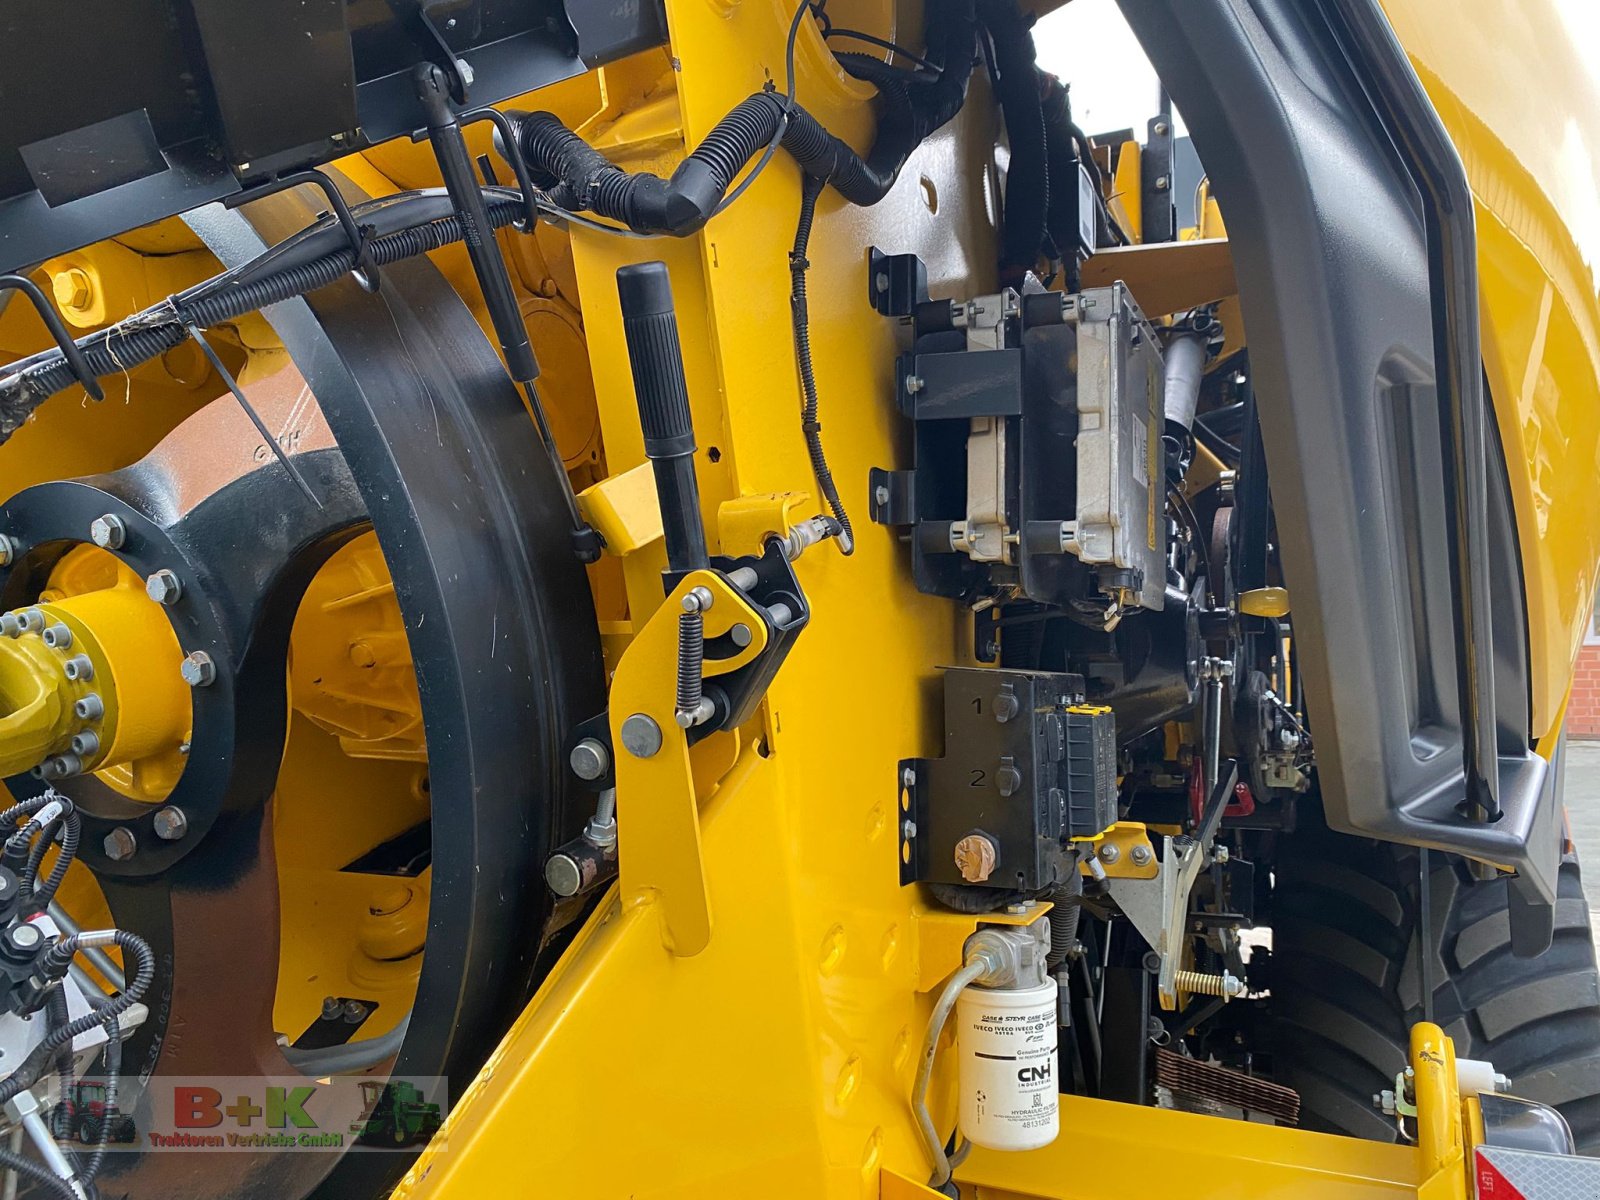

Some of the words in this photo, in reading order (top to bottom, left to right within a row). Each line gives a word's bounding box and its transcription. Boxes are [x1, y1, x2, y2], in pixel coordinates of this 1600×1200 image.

[971, 697, 981, 714] 1
[970, 769, 986, 787] 2
[973, 1024, 993, 1032] IVECO
[1018, 1062, 1051, 1082] CNH
[1018, 1079, 1051, 1088] INDUSTRIAL
[1011, 1107, 1043, 1115] HYDRAULIC
